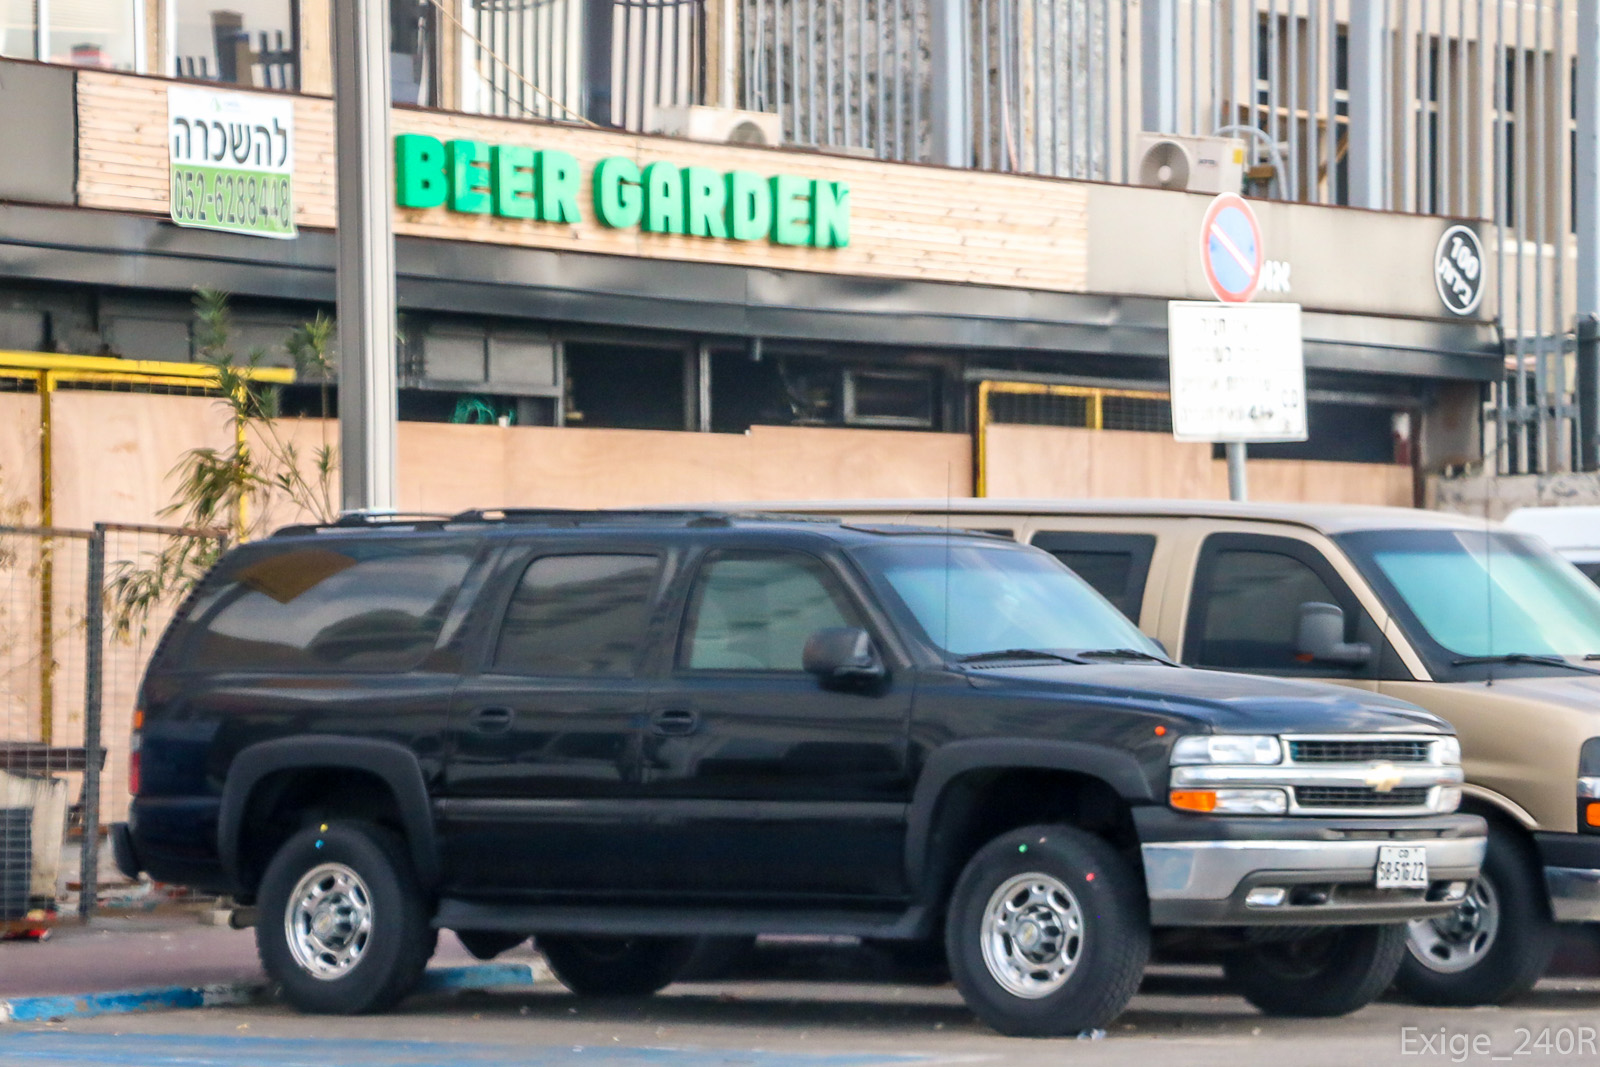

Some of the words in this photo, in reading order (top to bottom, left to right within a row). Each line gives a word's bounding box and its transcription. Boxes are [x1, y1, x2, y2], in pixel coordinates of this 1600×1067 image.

[173, 116, 288, 167] להשכרה
[395, 133, 581, 224] BEER
[593, 156, 850, 248] GARDEN
[1450, 236, 1480, 280] 100
